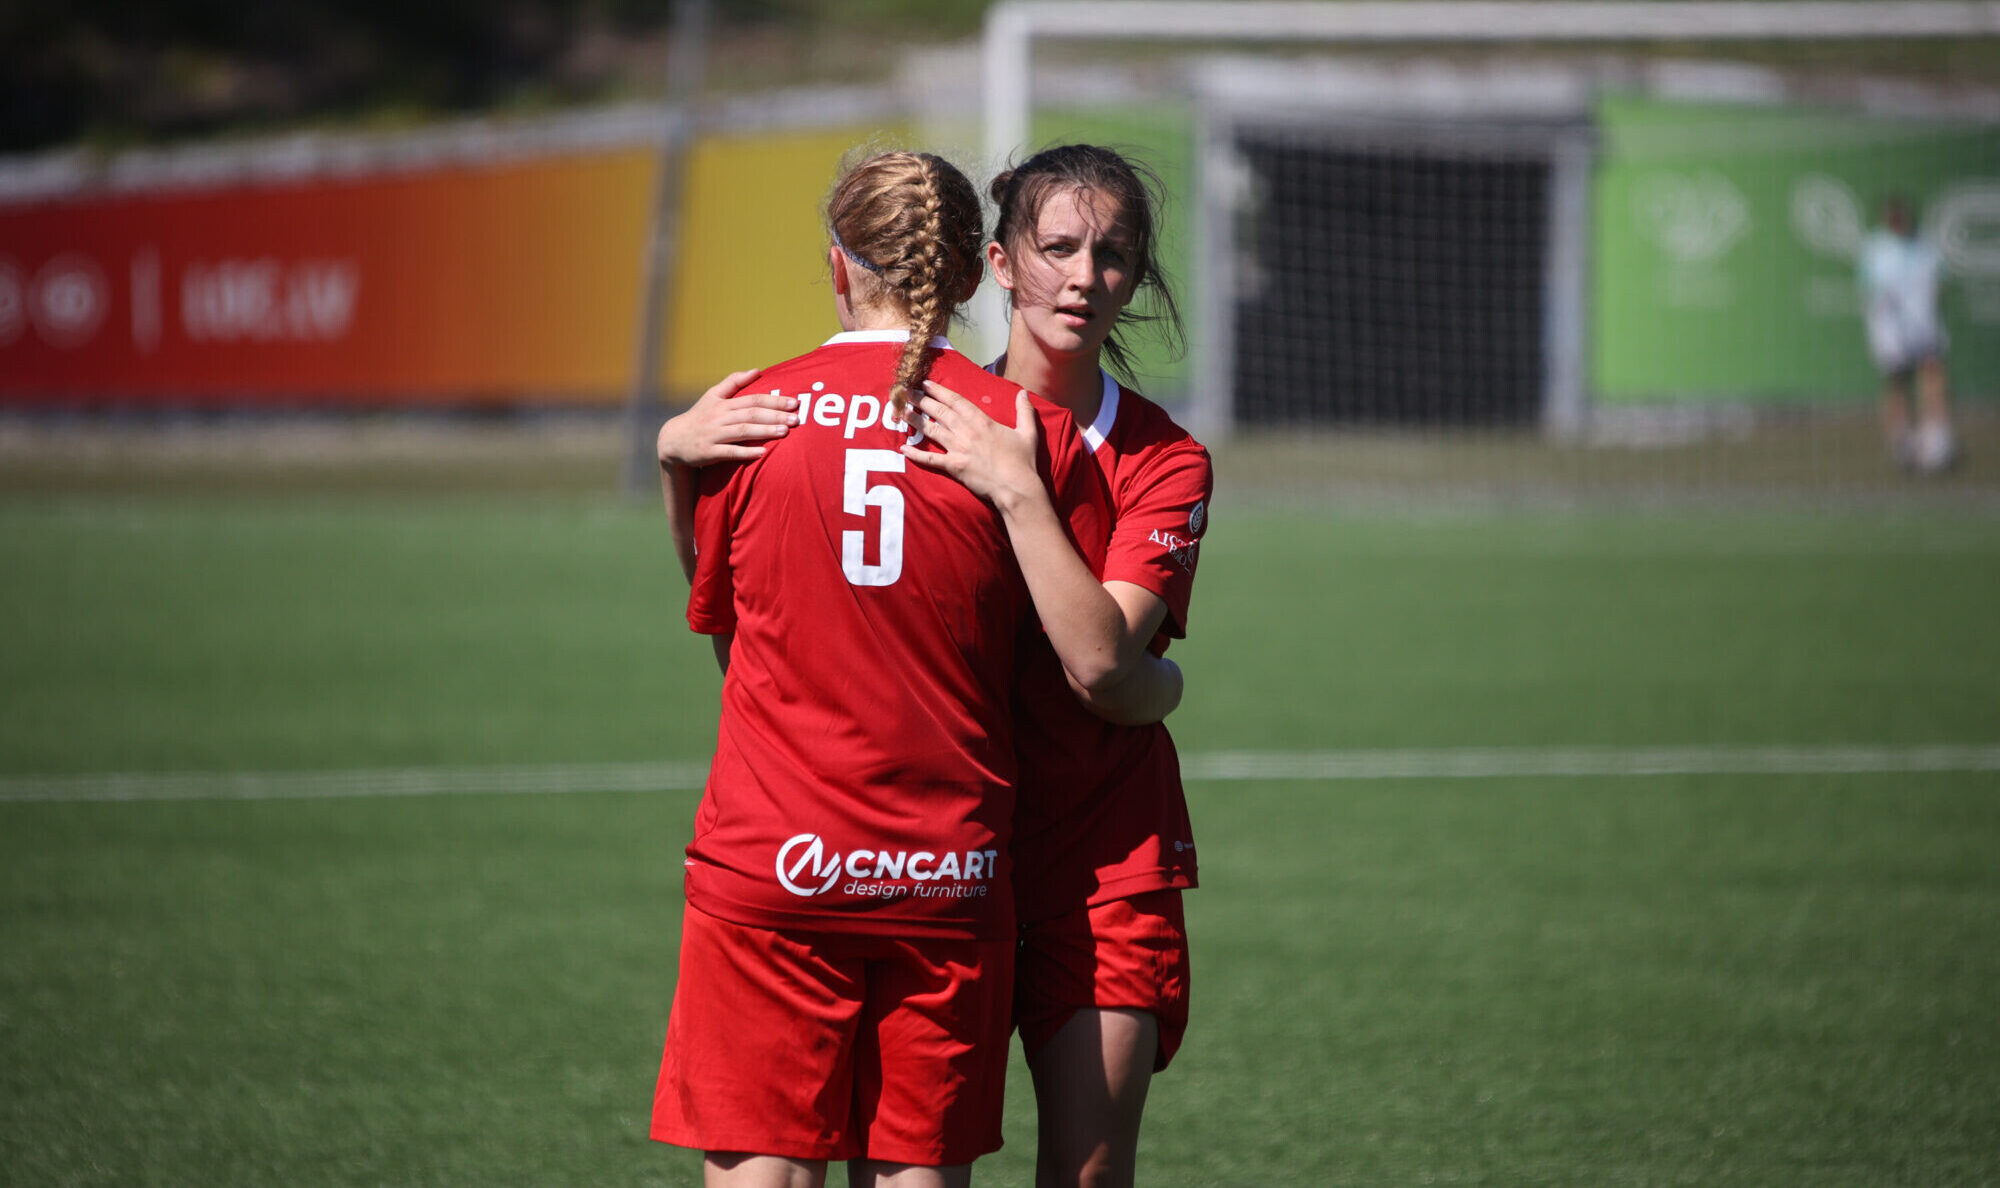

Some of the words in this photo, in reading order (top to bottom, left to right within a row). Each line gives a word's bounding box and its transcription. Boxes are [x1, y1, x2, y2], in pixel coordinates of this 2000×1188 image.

[842, 448, 905, 586] 5
[845, 849, 997, 881] CNCART
[843, 880, 907, 900] design
[913, 882, 987, 899] furniture
